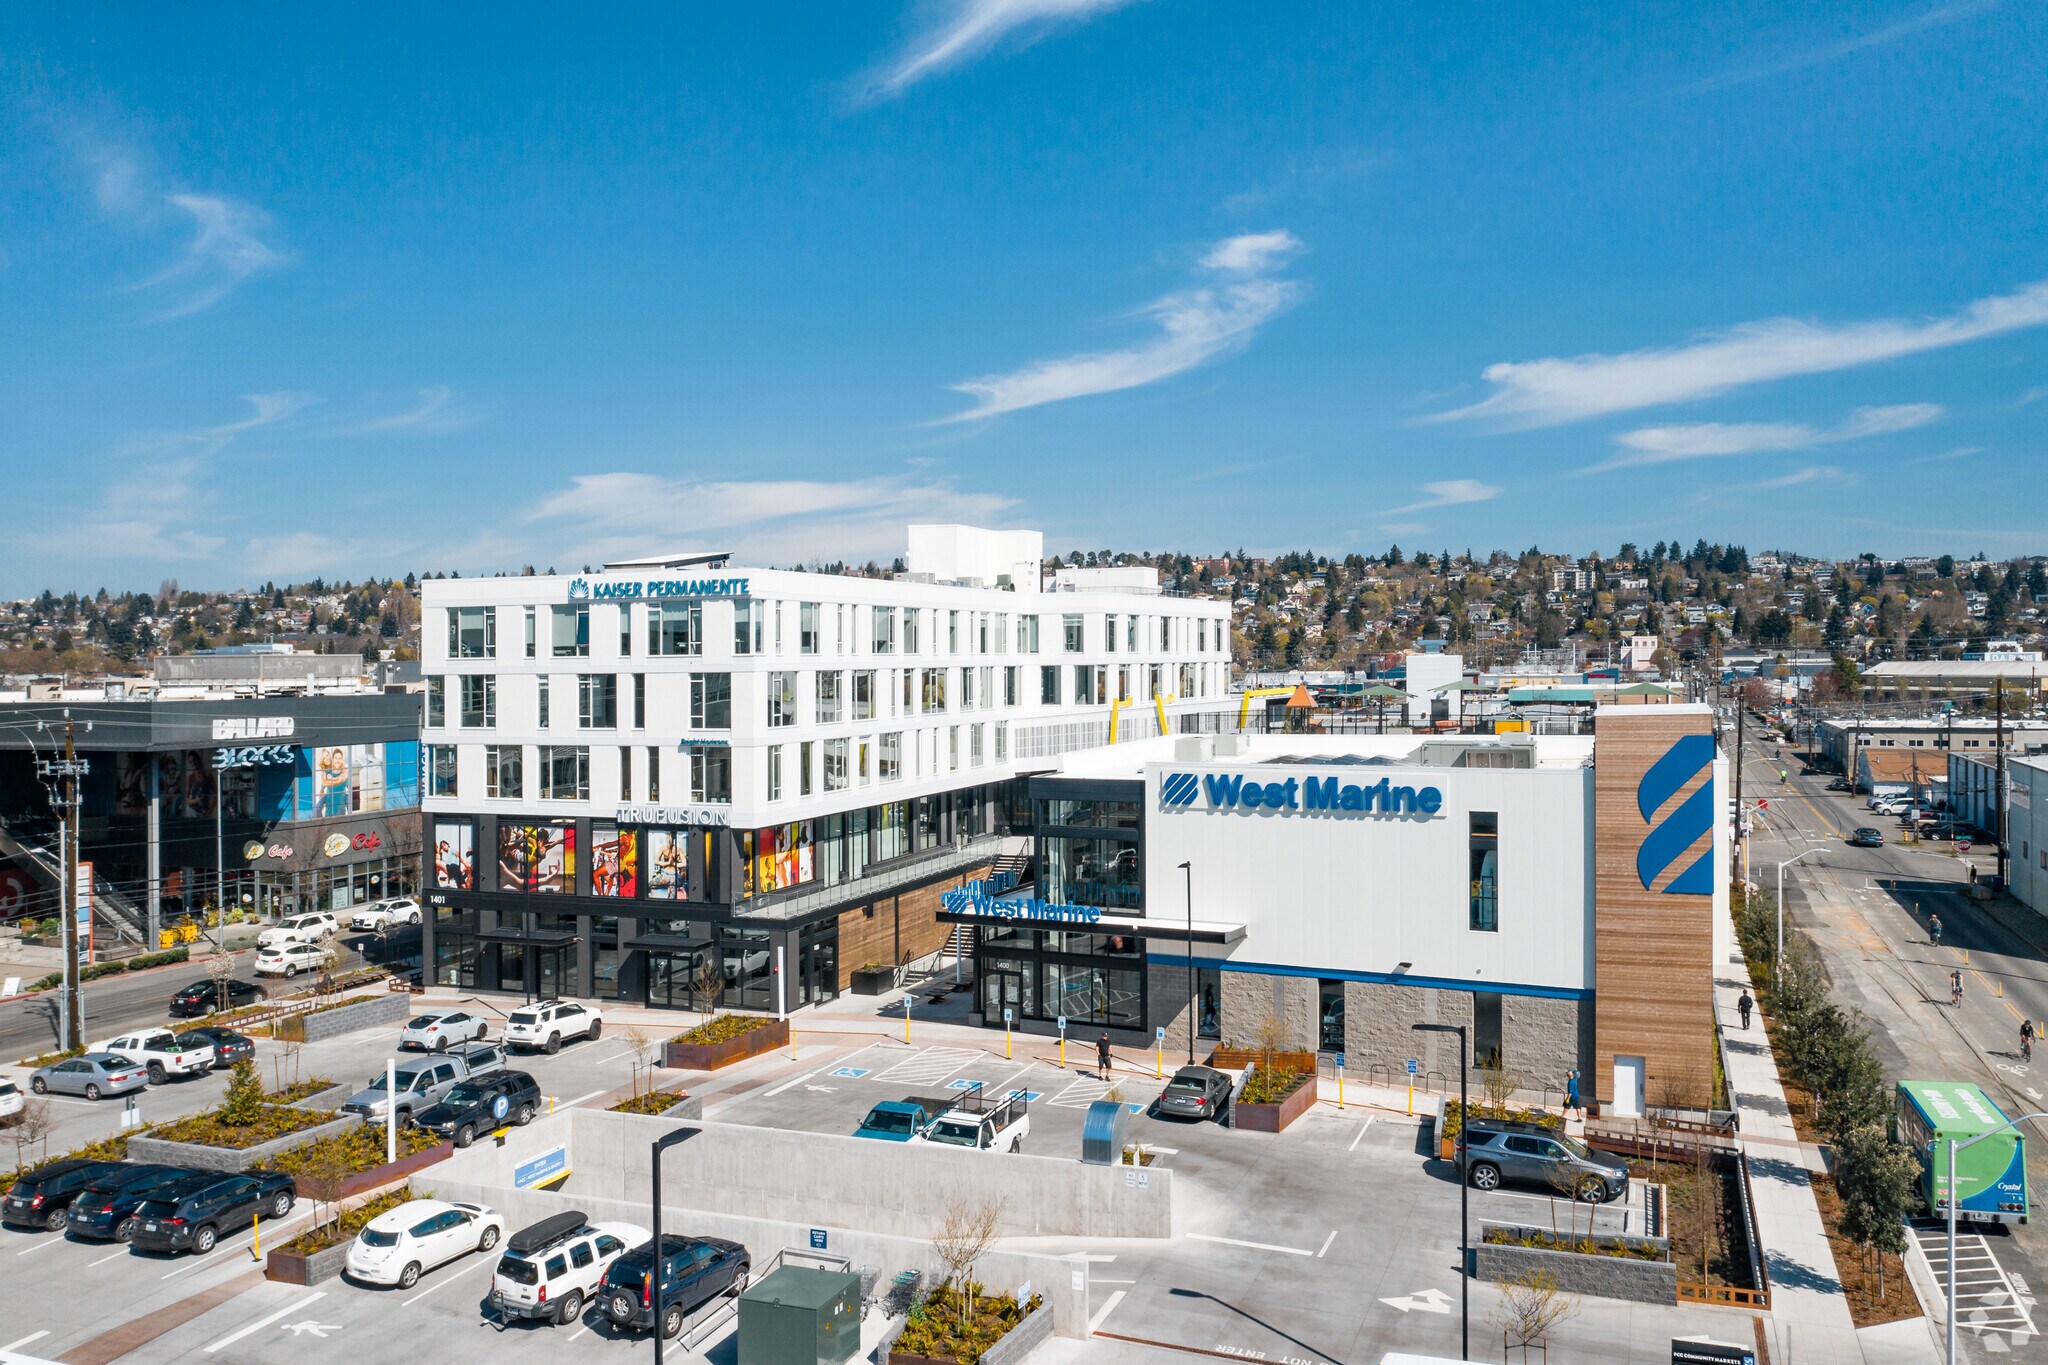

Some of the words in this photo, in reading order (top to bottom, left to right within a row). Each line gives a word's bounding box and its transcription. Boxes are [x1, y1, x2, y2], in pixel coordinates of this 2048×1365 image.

[593, 582, 643, 598] KAISER
[647, 577, 750, 596] PERMANENTE
[212, 716, 294, 740] BALLARD
[212, 744, 295, 768] BLOCKS
[1204, 773, 1299, 809] West
[1304, 776, 1442, 813] Marine
[617, 806, 728, 825] TRUFUSION
[430, 895, 445, 904] 1401
[973, 894, 1023, 918] West
[1028, 898, 1101, 924] Marine
[497, 1098, 507, 1117] P
[1997, 1182, 2022, 1191] Crystal
[1215, 1344, 1266, 1359] ENTER
[1684, 1353, 1715, 1361] COMMUNITY
[1714, 1356, 1741, 1364] MARKETS
